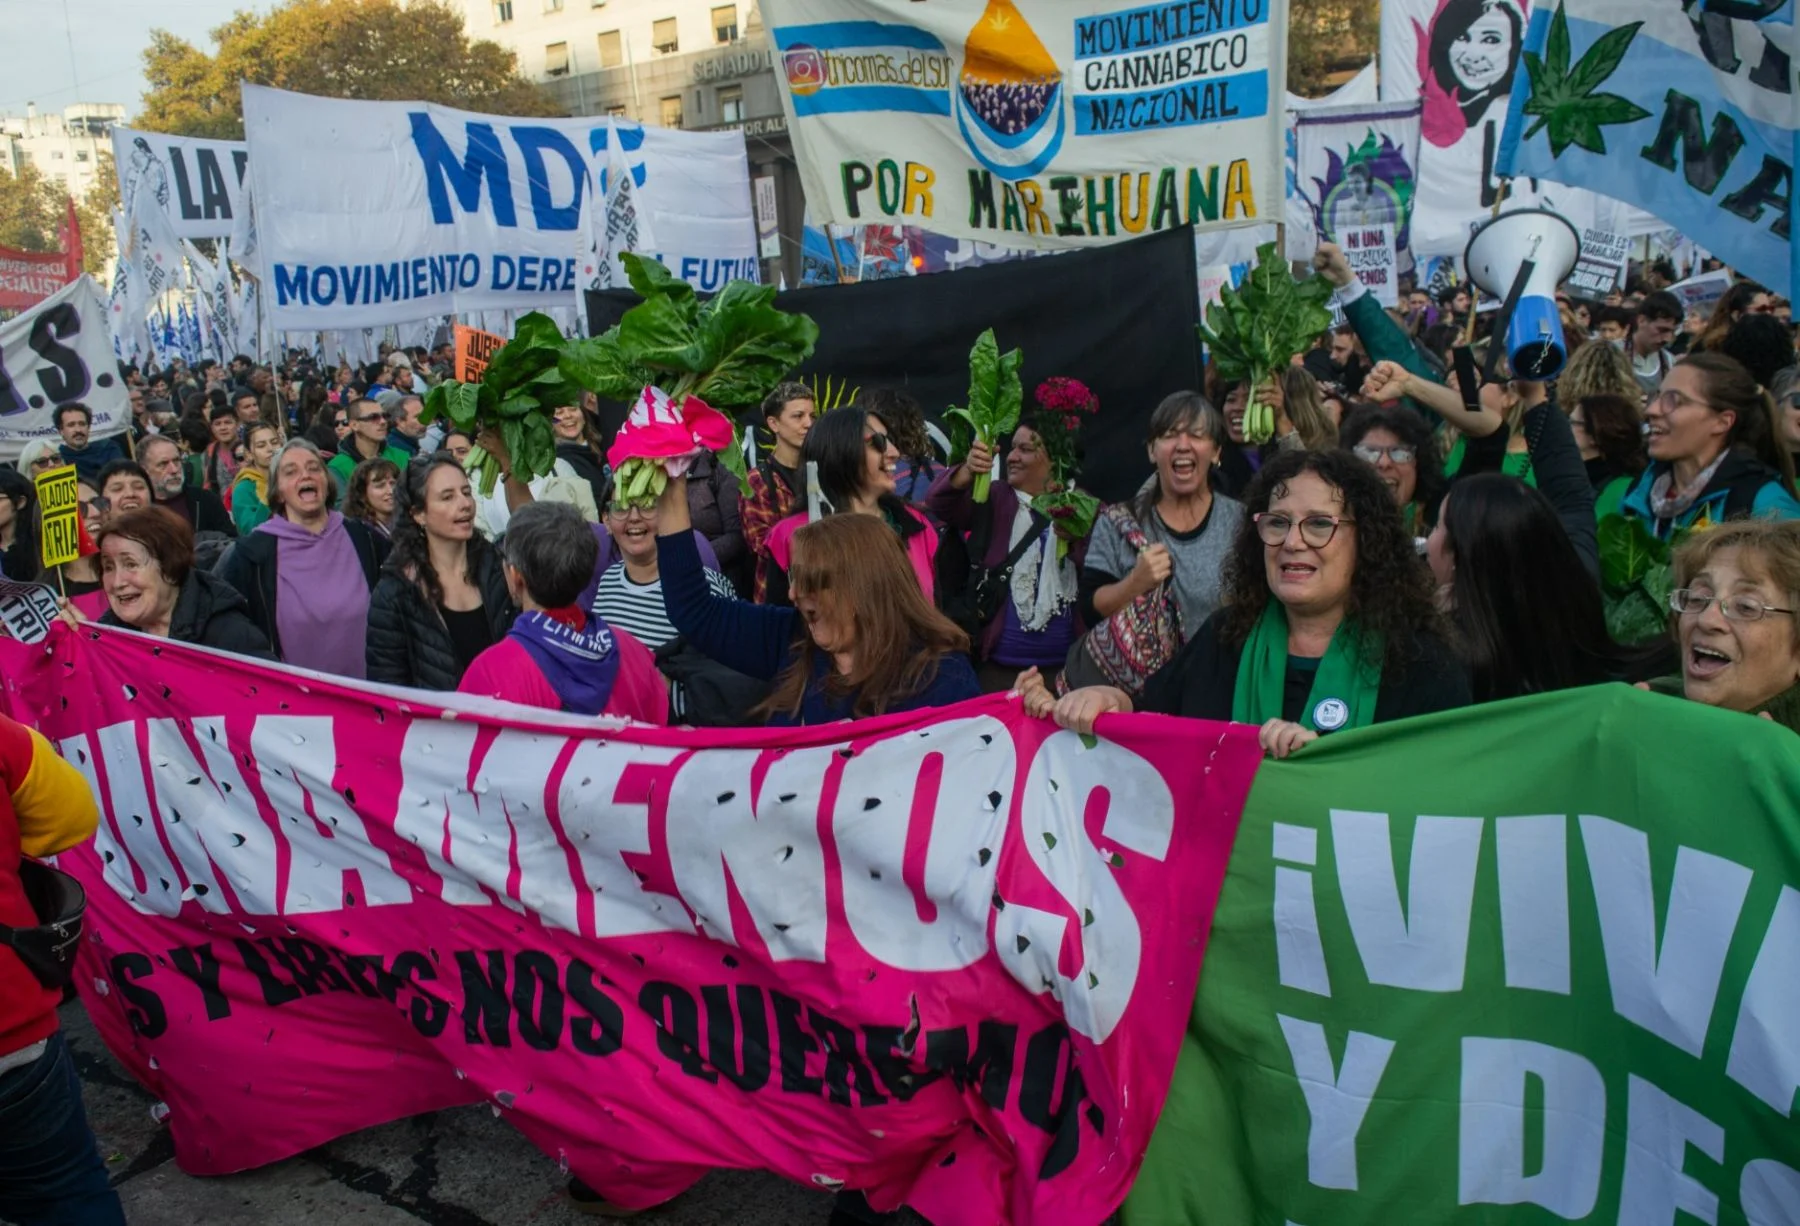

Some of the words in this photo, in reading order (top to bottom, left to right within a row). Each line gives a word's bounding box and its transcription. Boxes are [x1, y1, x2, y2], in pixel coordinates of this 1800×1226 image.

[1079, 0, 1261, 56] MOVIMIENTO
[693, 50, 760, 81] SENADO
[1085, 34, 1247, 91] CANNABICO
[1091, 82, 1238, 131] NACIONAL
[169, 147, 233, 219] LA
[841, 158, 937, 219] POR
[967, 158, 1258, 237] MARIHUANA
[1348, 232, 1359, 249] NI
[1361, 230, 1386, 247] UNA
[273, 253, 480, 305] MOVIMIENTO
[490, 254, 577, 292] DERE
[395, 714, 1174, 1045] MENOS
[455, 949, 625, 1056] NOS
[1276, 1013, 1397, 1191] Y
